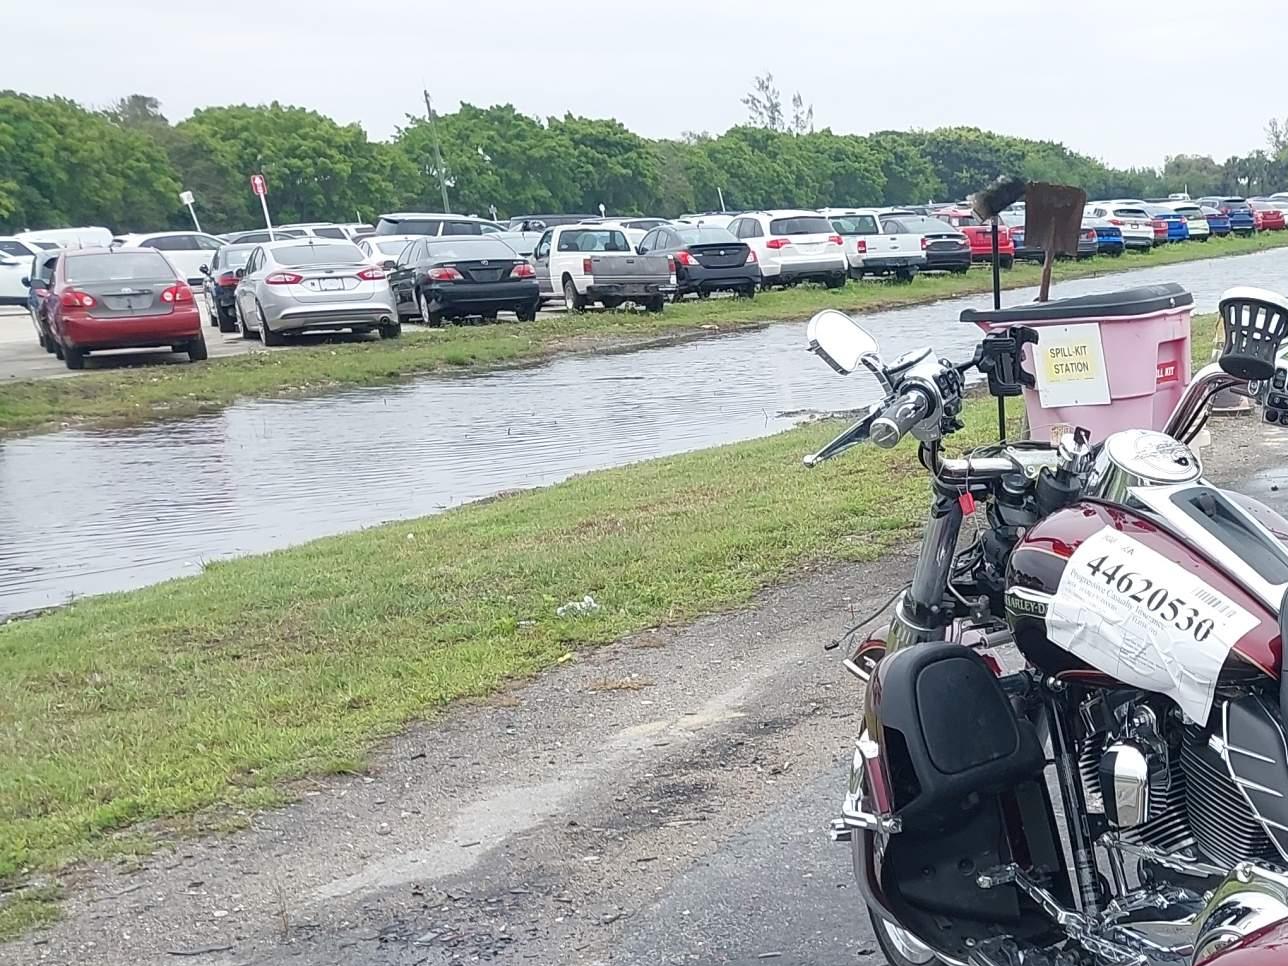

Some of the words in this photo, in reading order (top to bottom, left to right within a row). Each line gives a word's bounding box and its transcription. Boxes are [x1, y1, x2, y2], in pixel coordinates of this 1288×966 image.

[1049, 345, 1088, 359] SPILL-KIT
[1053, 361, 1090, 374] STATION
[1164, 366, 1175, 377] KIT
[1087, 556, 1214, 642] 44620530
